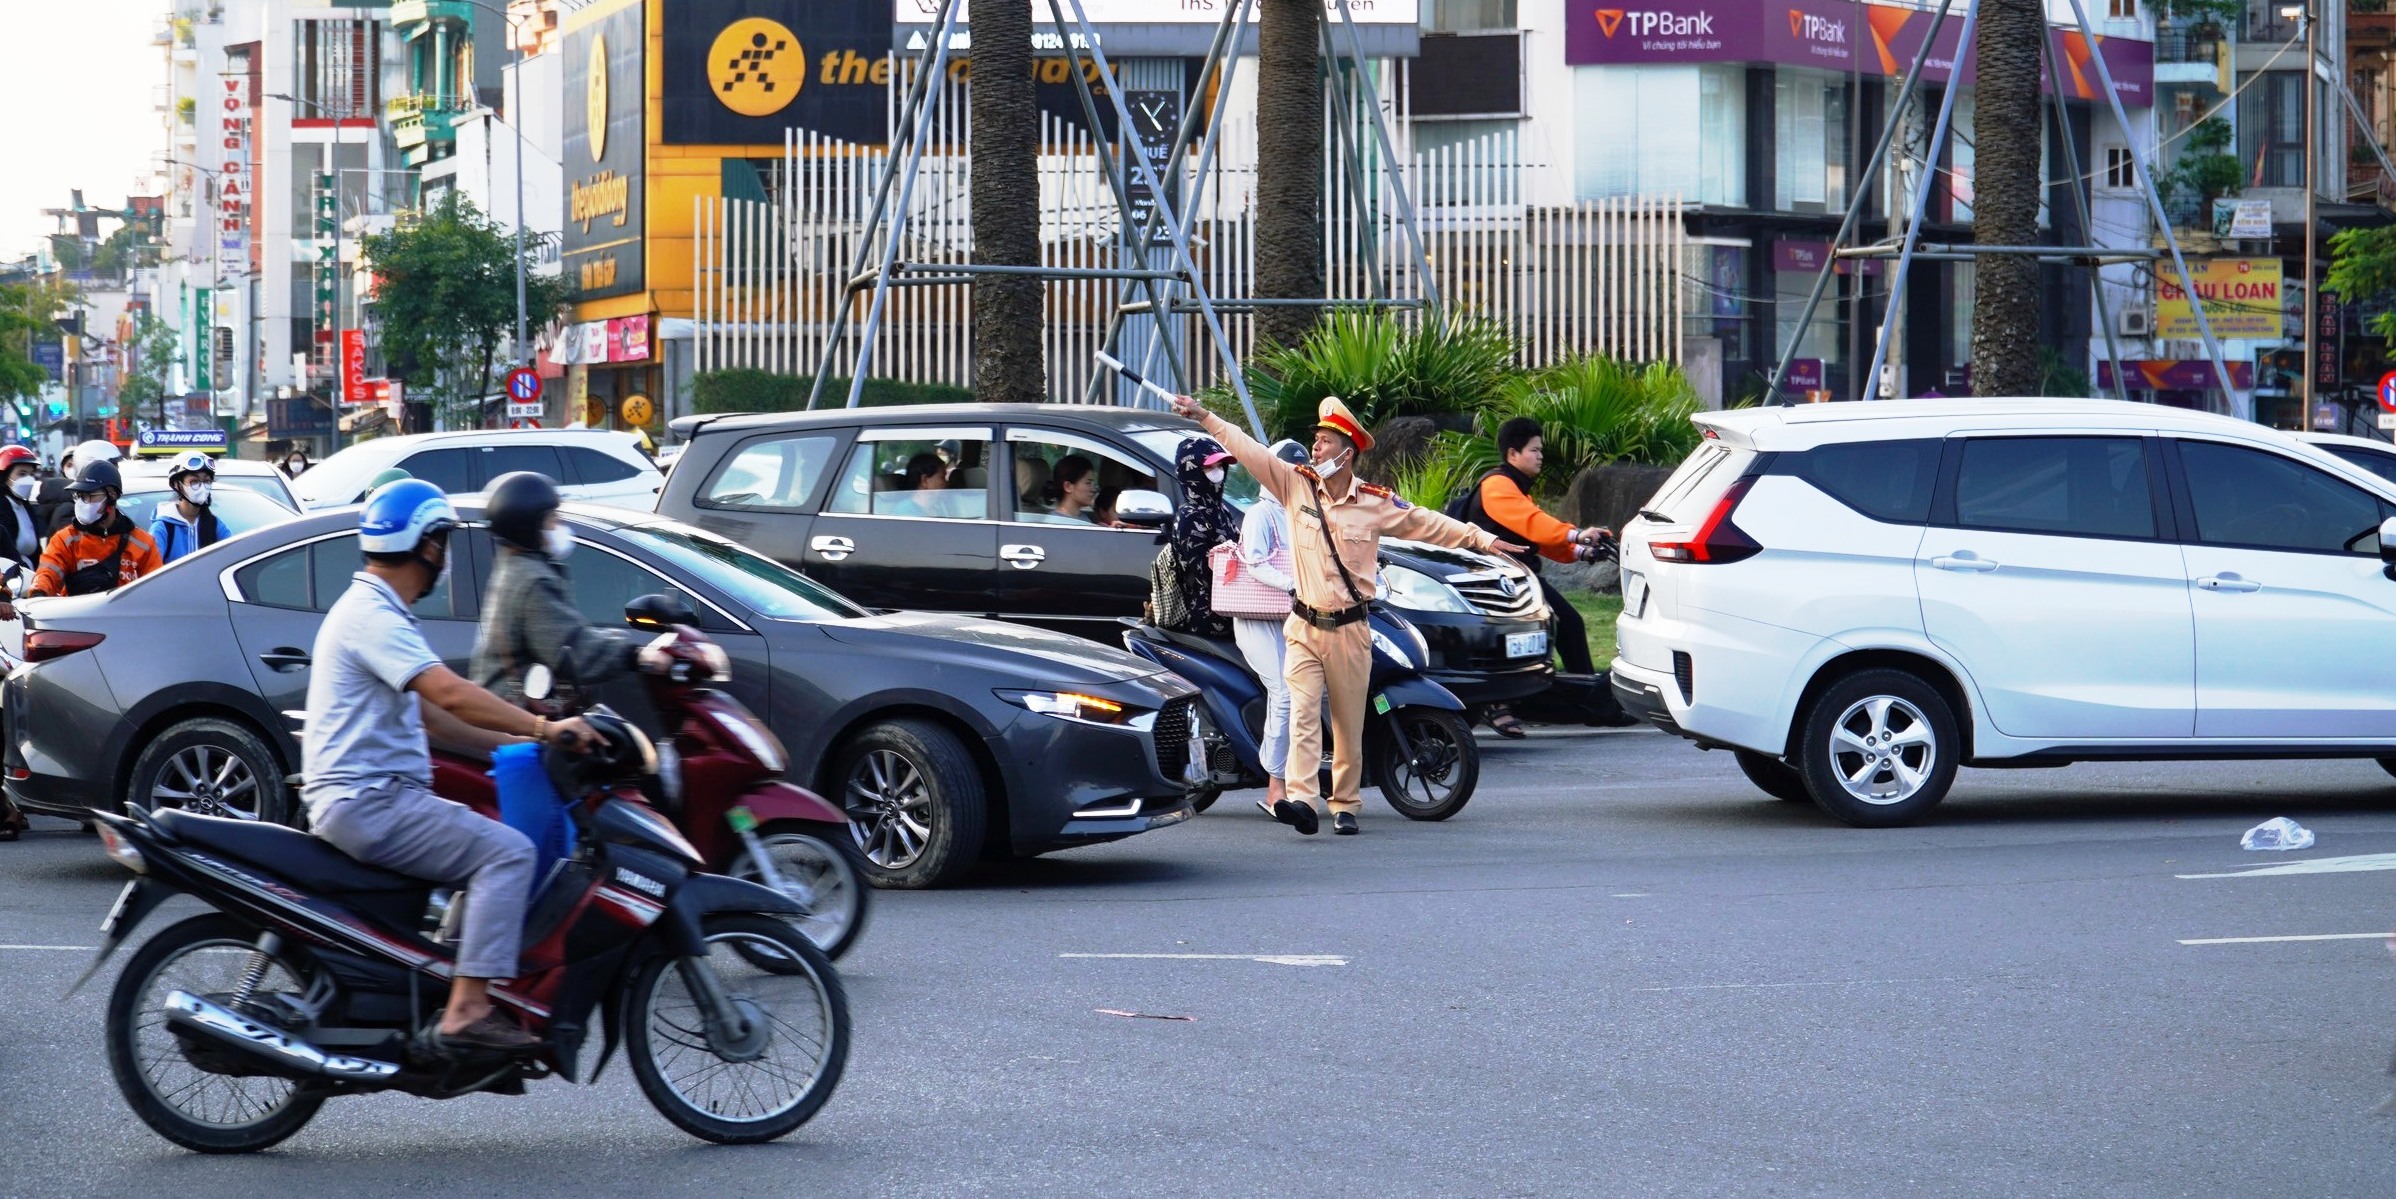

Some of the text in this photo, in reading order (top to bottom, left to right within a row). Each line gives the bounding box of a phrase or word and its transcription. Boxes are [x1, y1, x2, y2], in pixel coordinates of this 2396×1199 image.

[1626, 10, 1714, 36] TPBank
[1804, 14, 1846, 44] TPBank
[223, 80, 241, 150] VỌNG
[2223, 282, 2276, 300] LOAN
[351, 332, 367, 399] SAKOS
